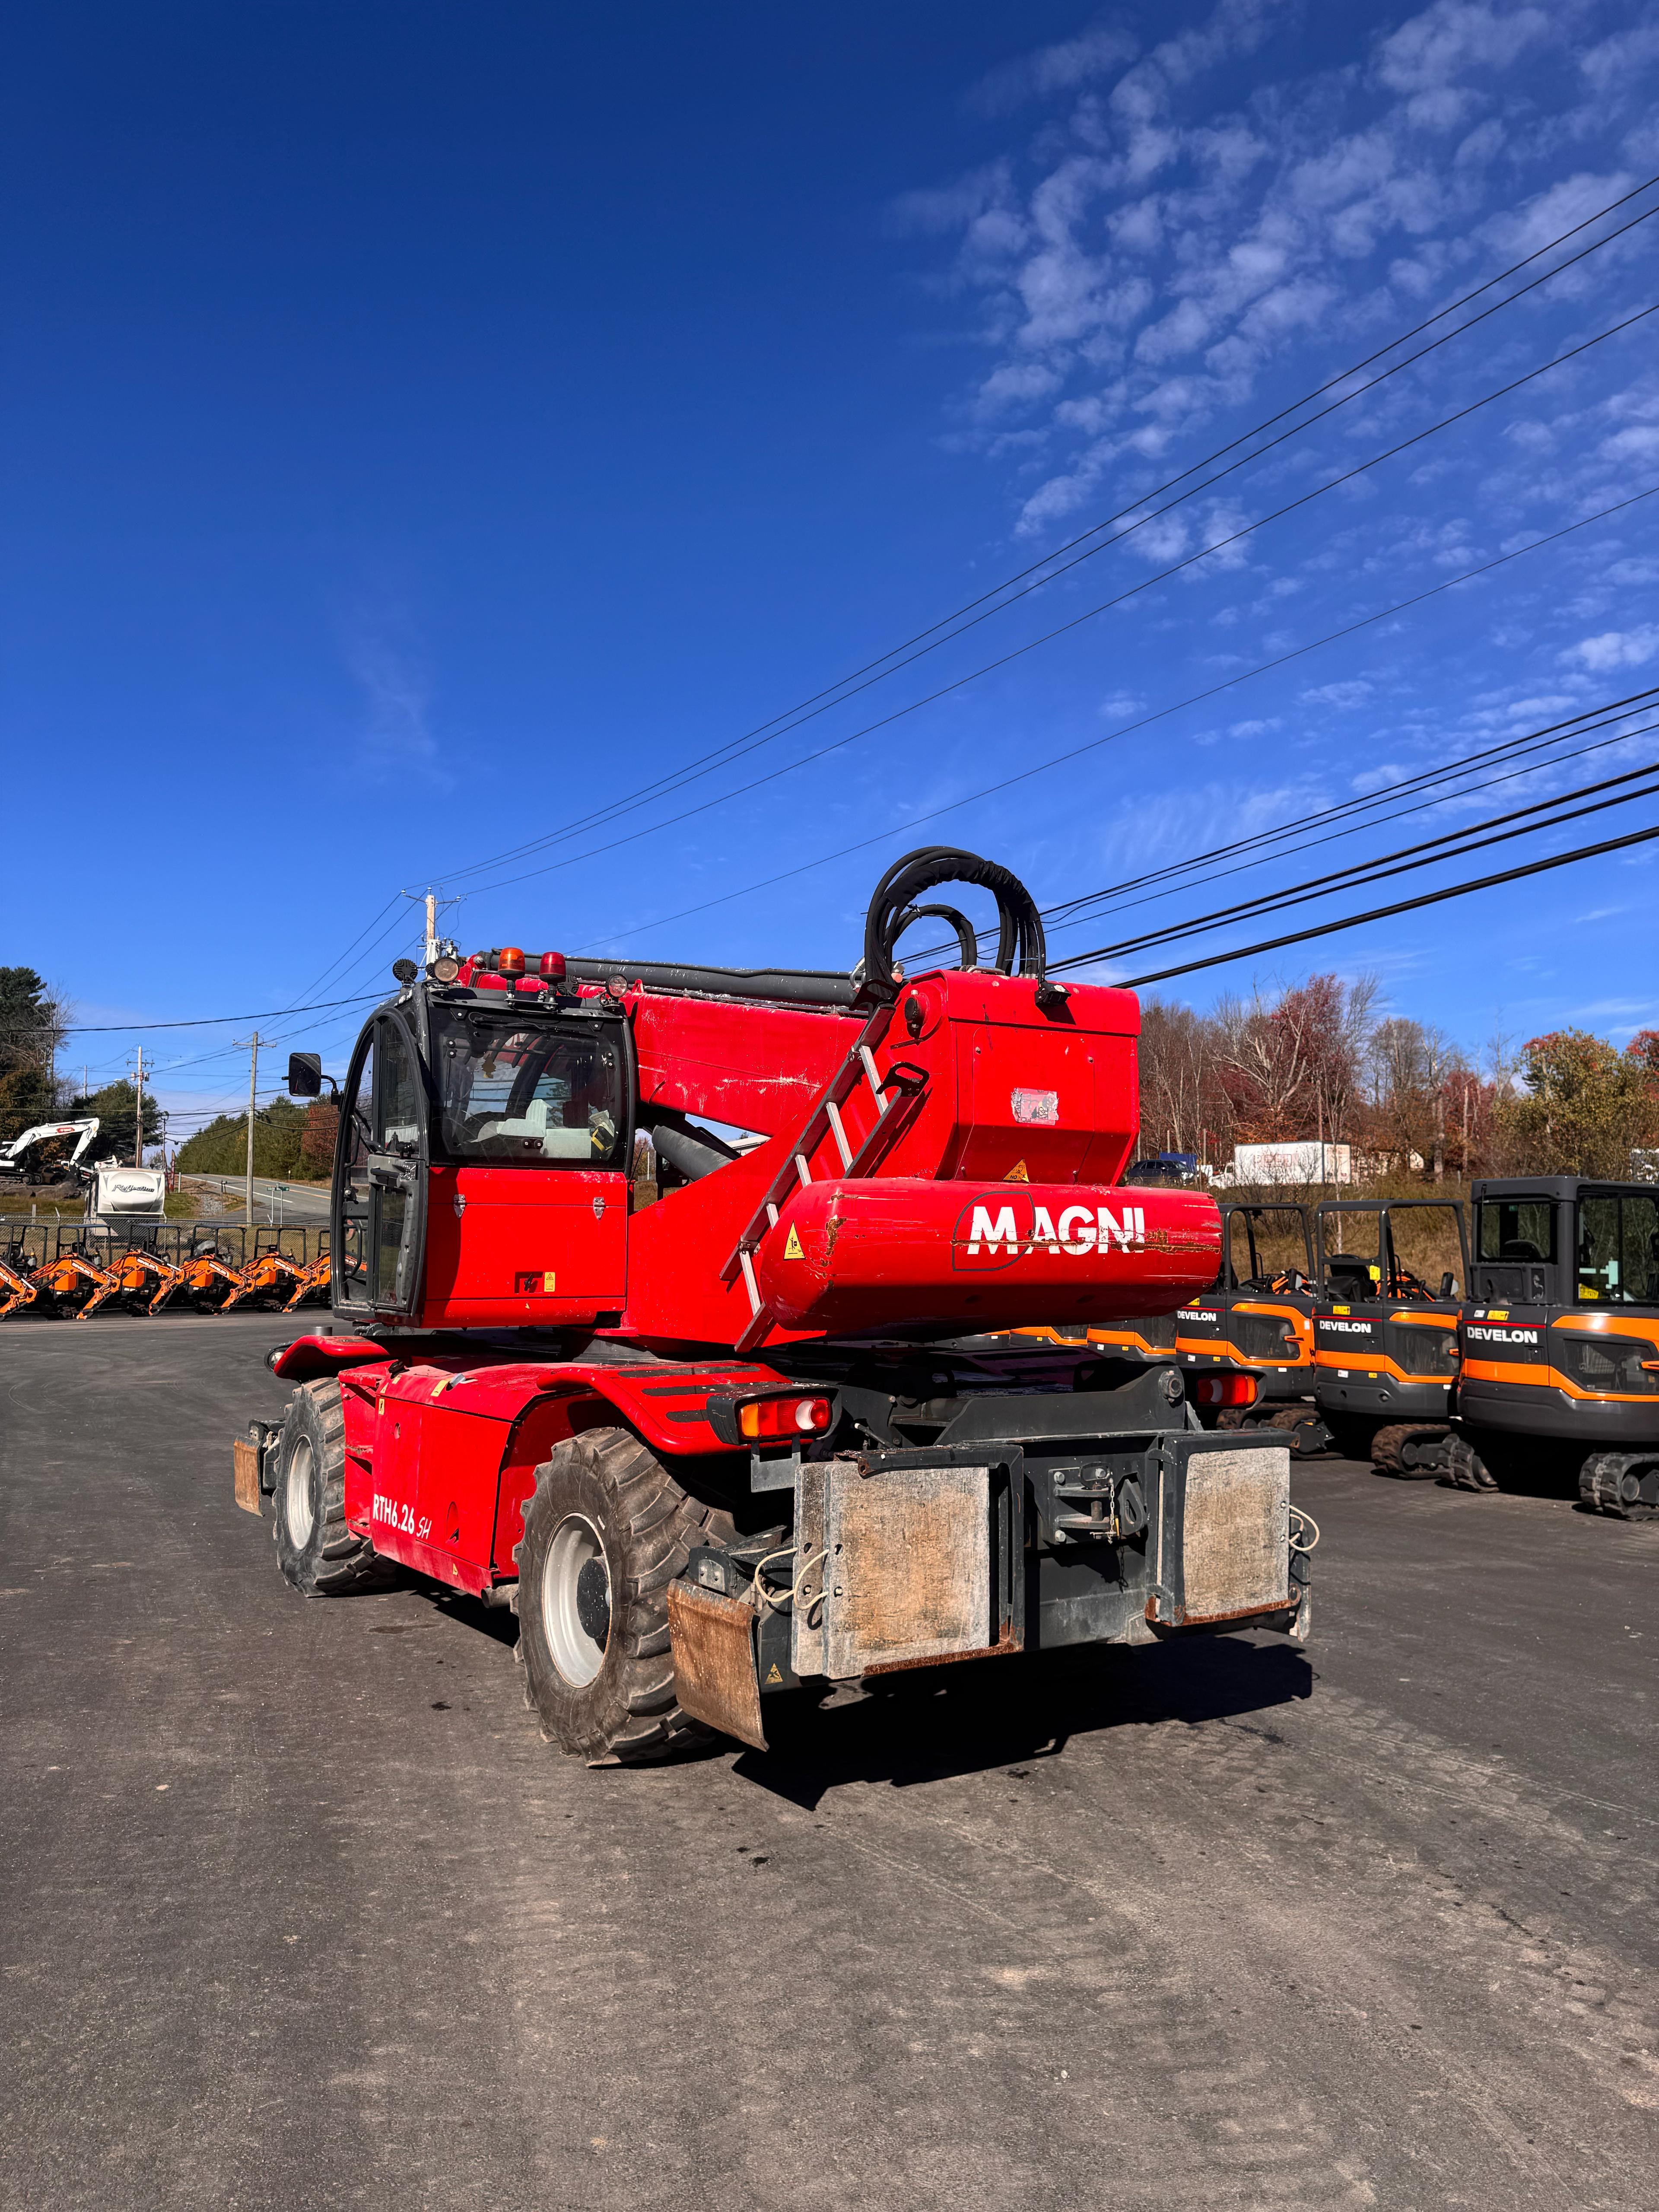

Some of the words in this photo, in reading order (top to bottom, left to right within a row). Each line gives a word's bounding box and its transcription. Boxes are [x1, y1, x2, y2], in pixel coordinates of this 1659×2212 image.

[967, 1206, 1145, 1255] MAGNI
[1177, 1310, 1216, 1322] DEVELON
[1319, 1320, 1371, 1333] DEVELON
[1467, 1326, 1538, 1344] DEVELON
[372, 1493, 415, 1535] RTH6.26
[416, 1516, 432, 1540] SH
